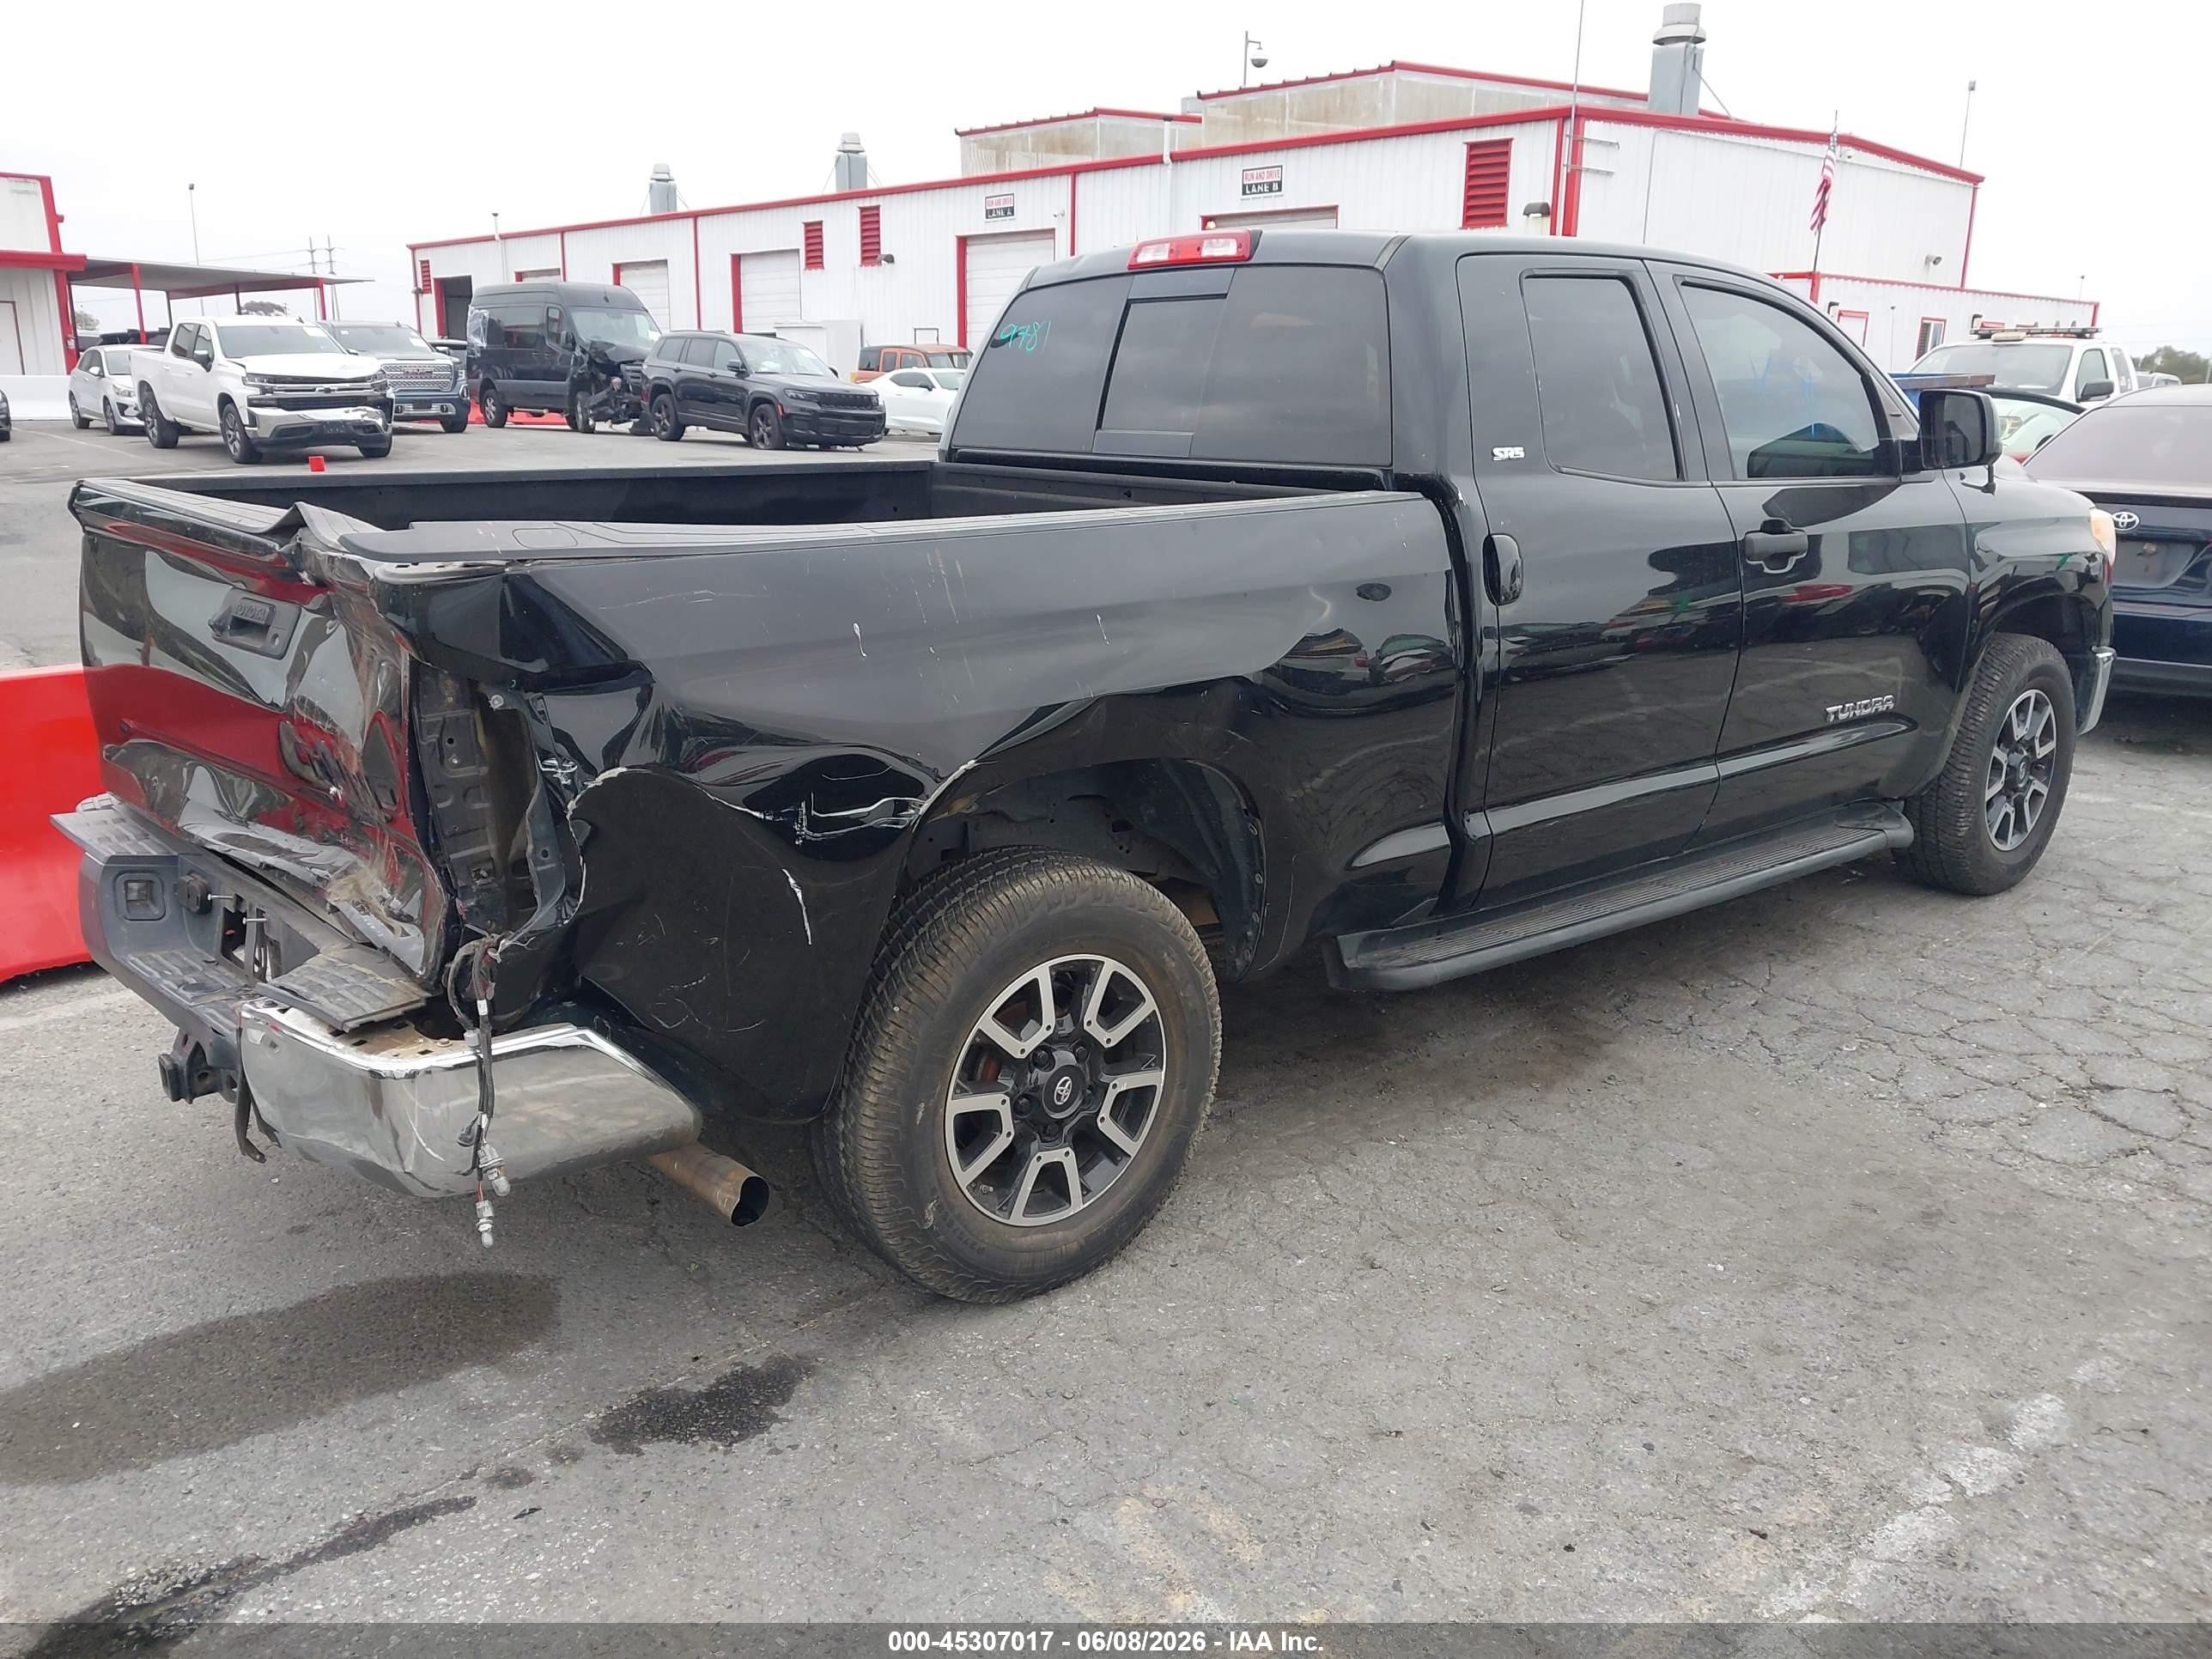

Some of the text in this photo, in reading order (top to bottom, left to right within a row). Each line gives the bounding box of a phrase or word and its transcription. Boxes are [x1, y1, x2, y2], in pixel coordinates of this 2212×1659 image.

[1244, 169, 1279, 181] RUN AND DRIVE
[1245, 182, 1279, 194] LANE B
[988, 207, 1012, 217] LANE A
[1492, 447, 1525, 461] SR5
[1826, 695, 1894, 722] TUNDRA
